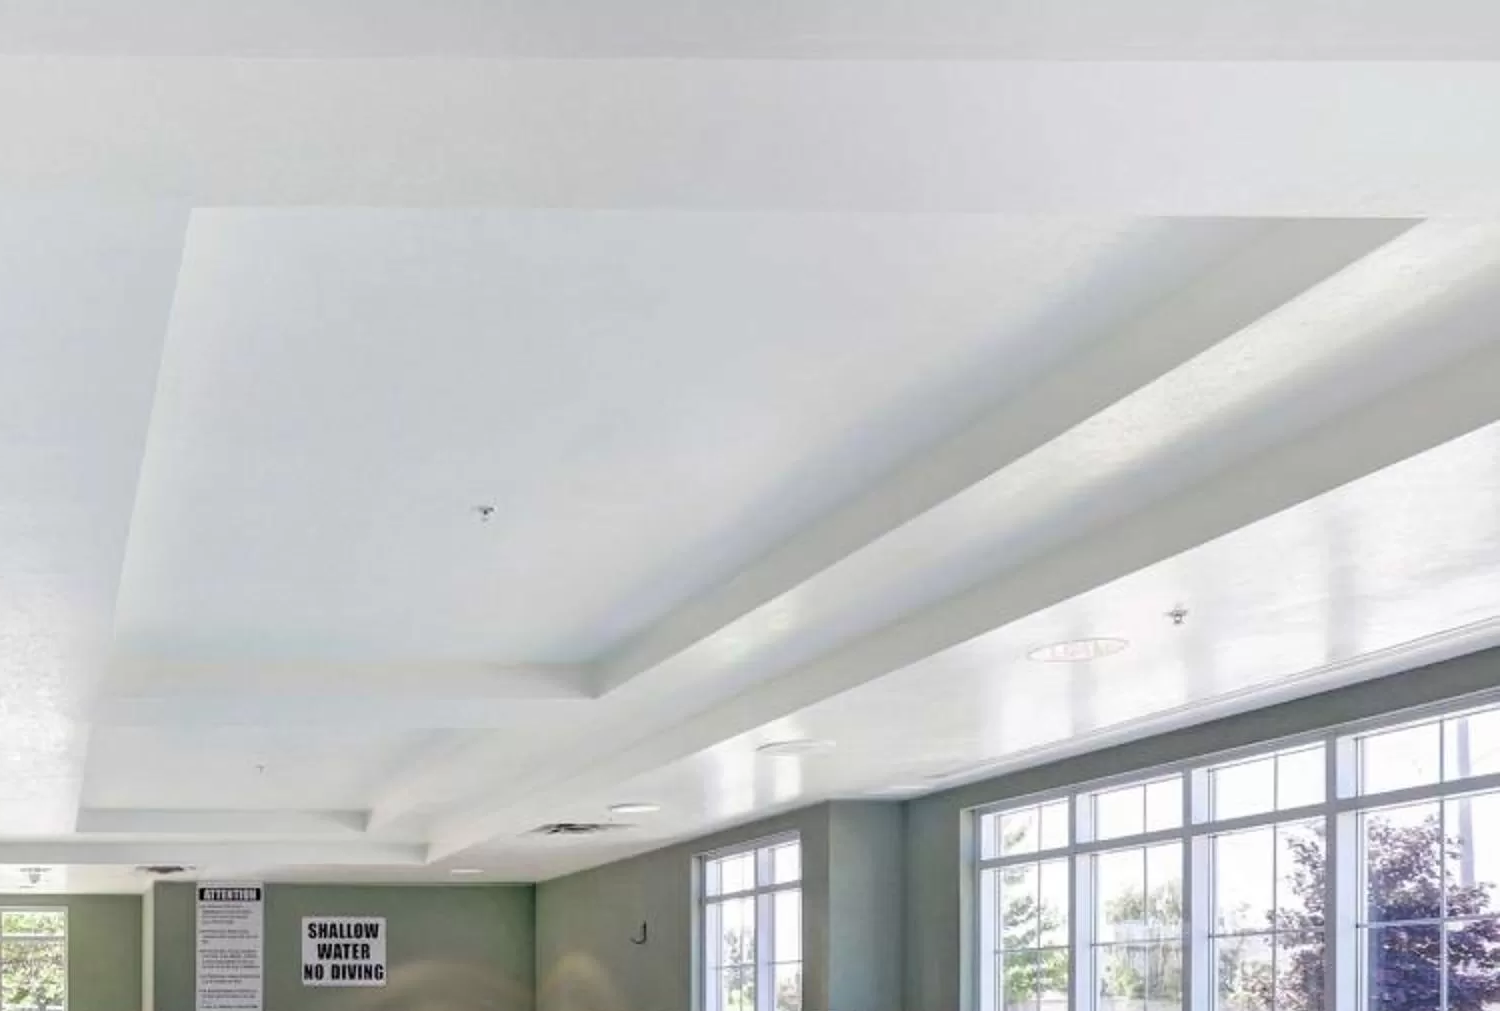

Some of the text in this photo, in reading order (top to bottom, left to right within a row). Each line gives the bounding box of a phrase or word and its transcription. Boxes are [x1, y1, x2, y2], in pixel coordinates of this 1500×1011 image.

[307, 923, 380, 939] SHALLOW
[317, 943, 371, 960] WATER
[303, 963, 385, 981] NO DIVING
